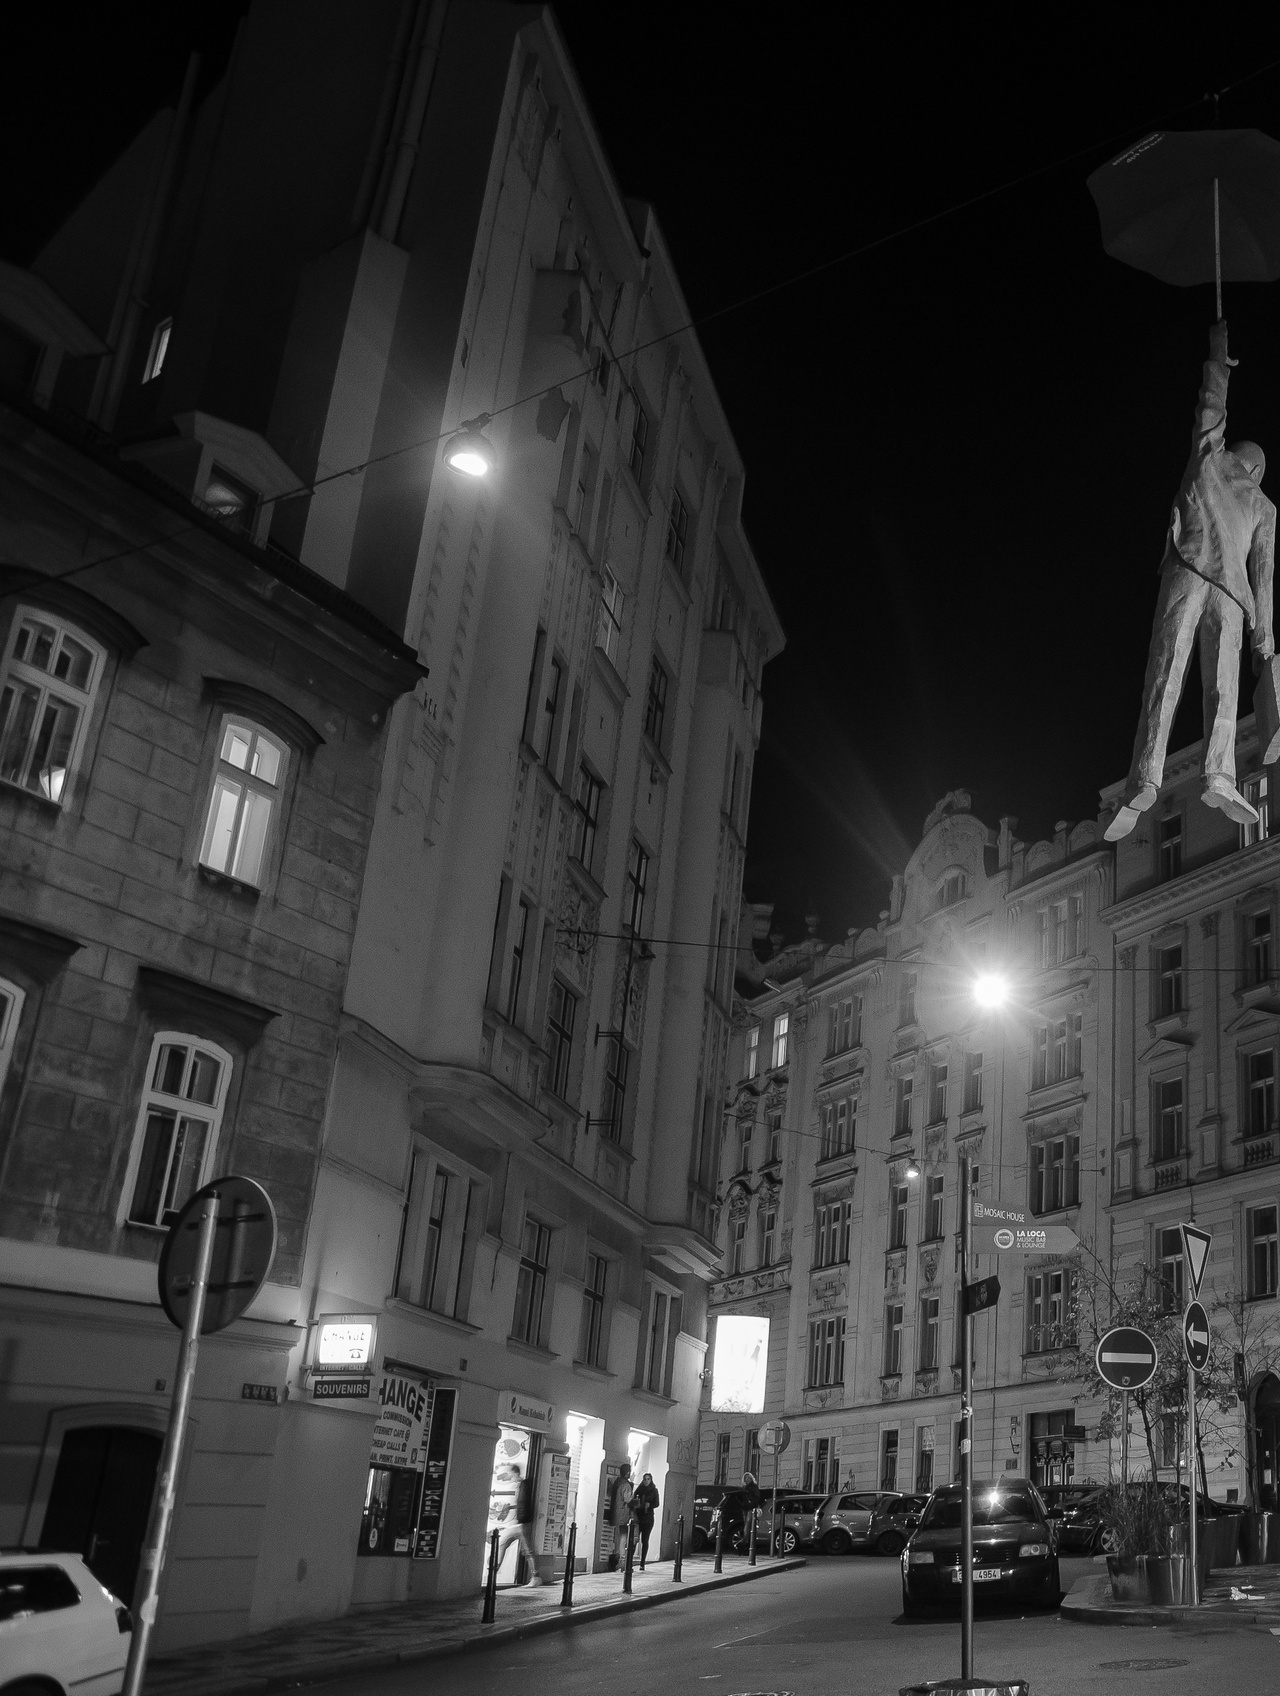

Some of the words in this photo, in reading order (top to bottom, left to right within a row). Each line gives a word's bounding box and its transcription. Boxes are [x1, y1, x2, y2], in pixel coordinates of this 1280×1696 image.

[984, 1207, 1006, 1220] MOSAIC
[1006, 1211, 1025, 1223] HOUSE
[316, 1383, 368, 1395] SOUVENIRS
[978, 1570, 997, 1579] 4954
